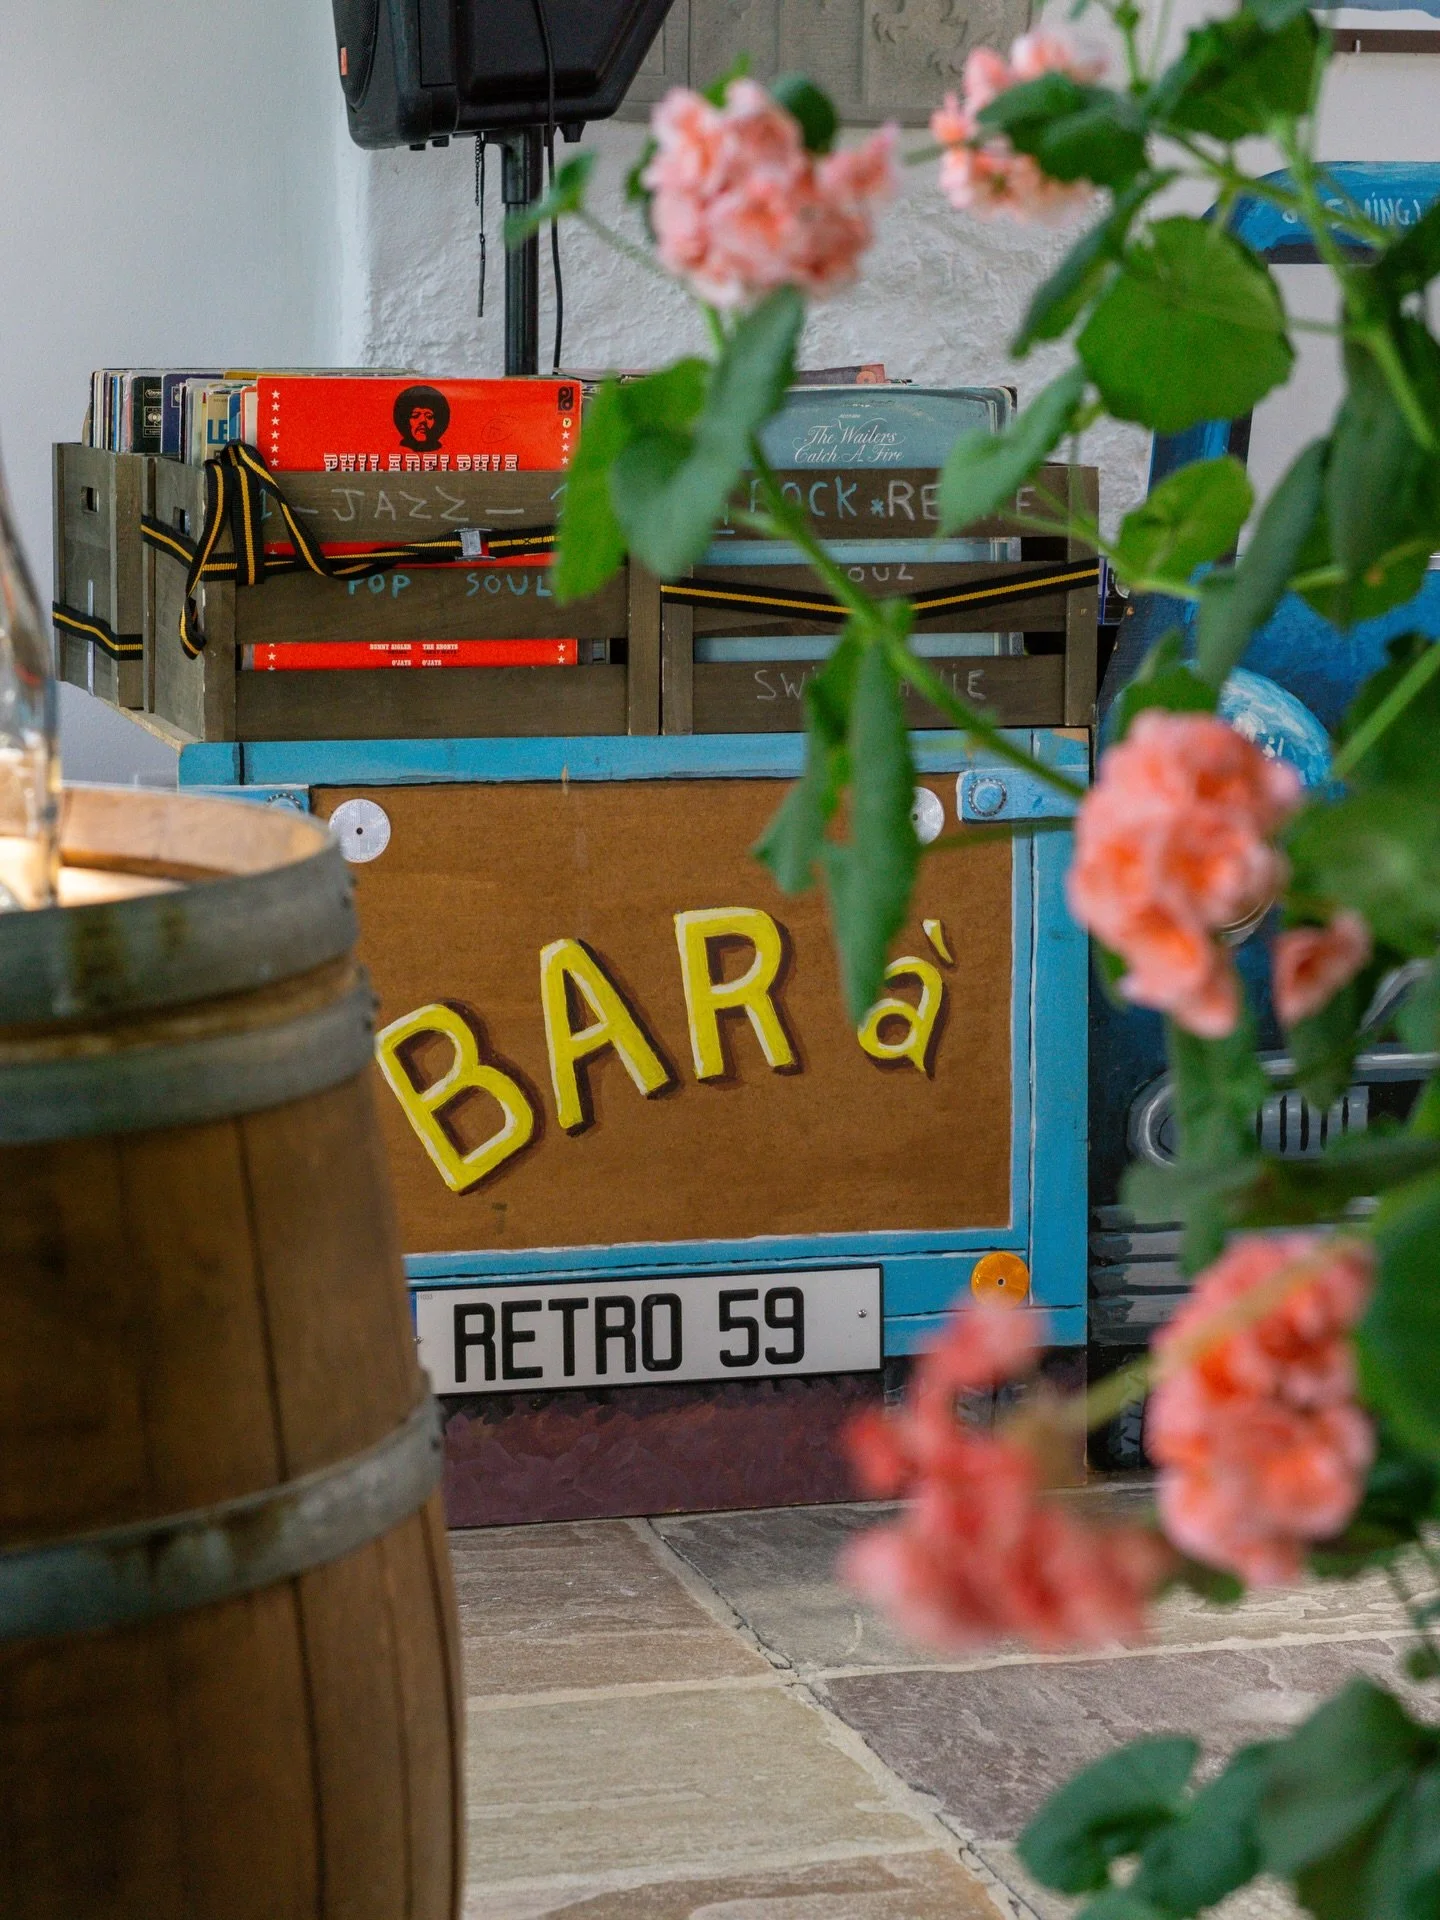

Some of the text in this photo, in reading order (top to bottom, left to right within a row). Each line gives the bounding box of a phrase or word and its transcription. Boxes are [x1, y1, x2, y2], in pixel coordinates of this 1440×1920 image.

[806, 418, 900, 445] The Wailers
[793, 440, 906, 463] Catch A Fire
[331, 485, 470, 522] JAZZ
[466, 572, 554, 598] SOUL
[828, 564, 916, 583] OUL
[375, 906, 798, 1193] BAR
[454, 1286, 805, 1383] RETRO 59
